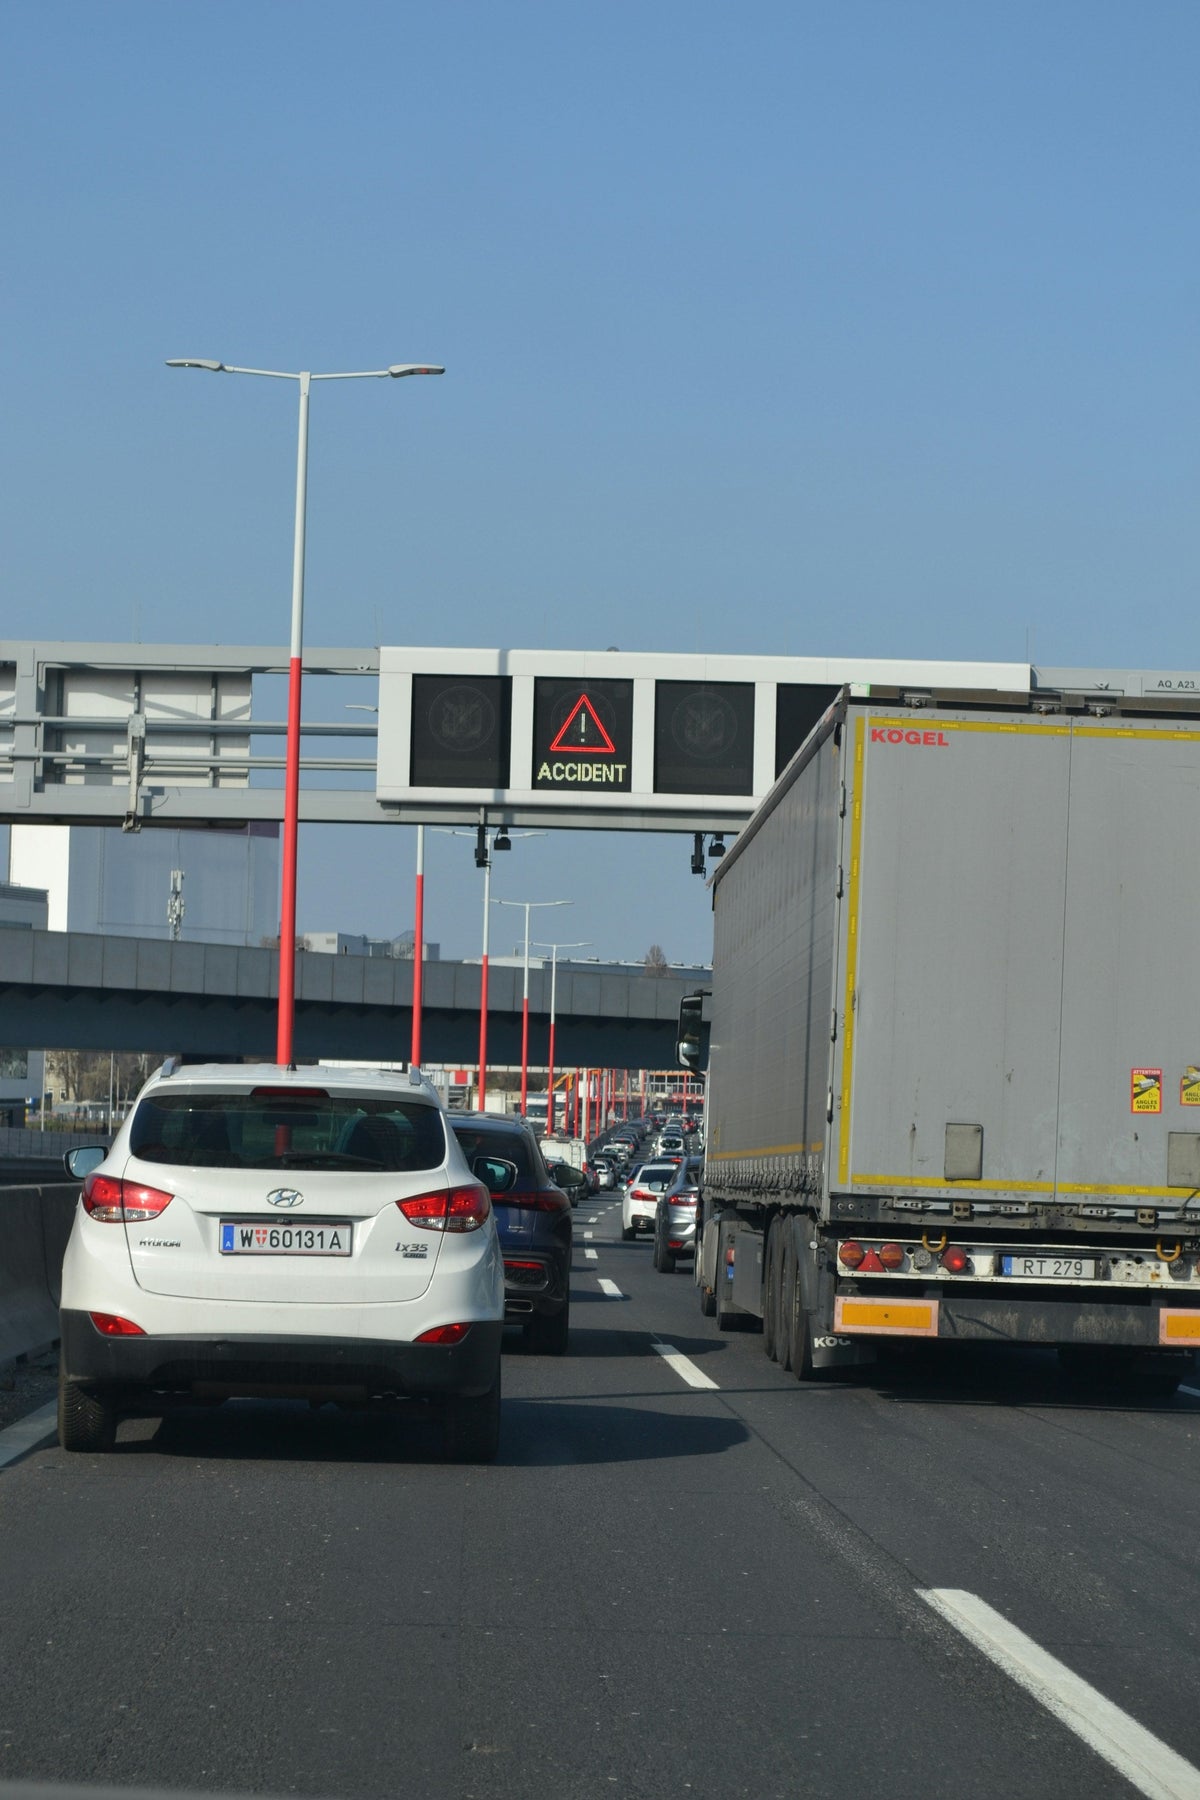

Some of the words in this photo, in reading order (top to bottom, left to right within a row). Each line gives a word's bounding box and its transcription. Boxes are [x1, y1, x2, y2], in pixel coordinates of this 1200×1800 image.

[871, 728, 949, 747] KÖGEL
[537, 762, 627, 783] ACCIDENT
[240, 1229, 254, 1248] W
[1023, 1259, 1047, 1275] RT
[1053, 1260, 1083, 1276] 279
